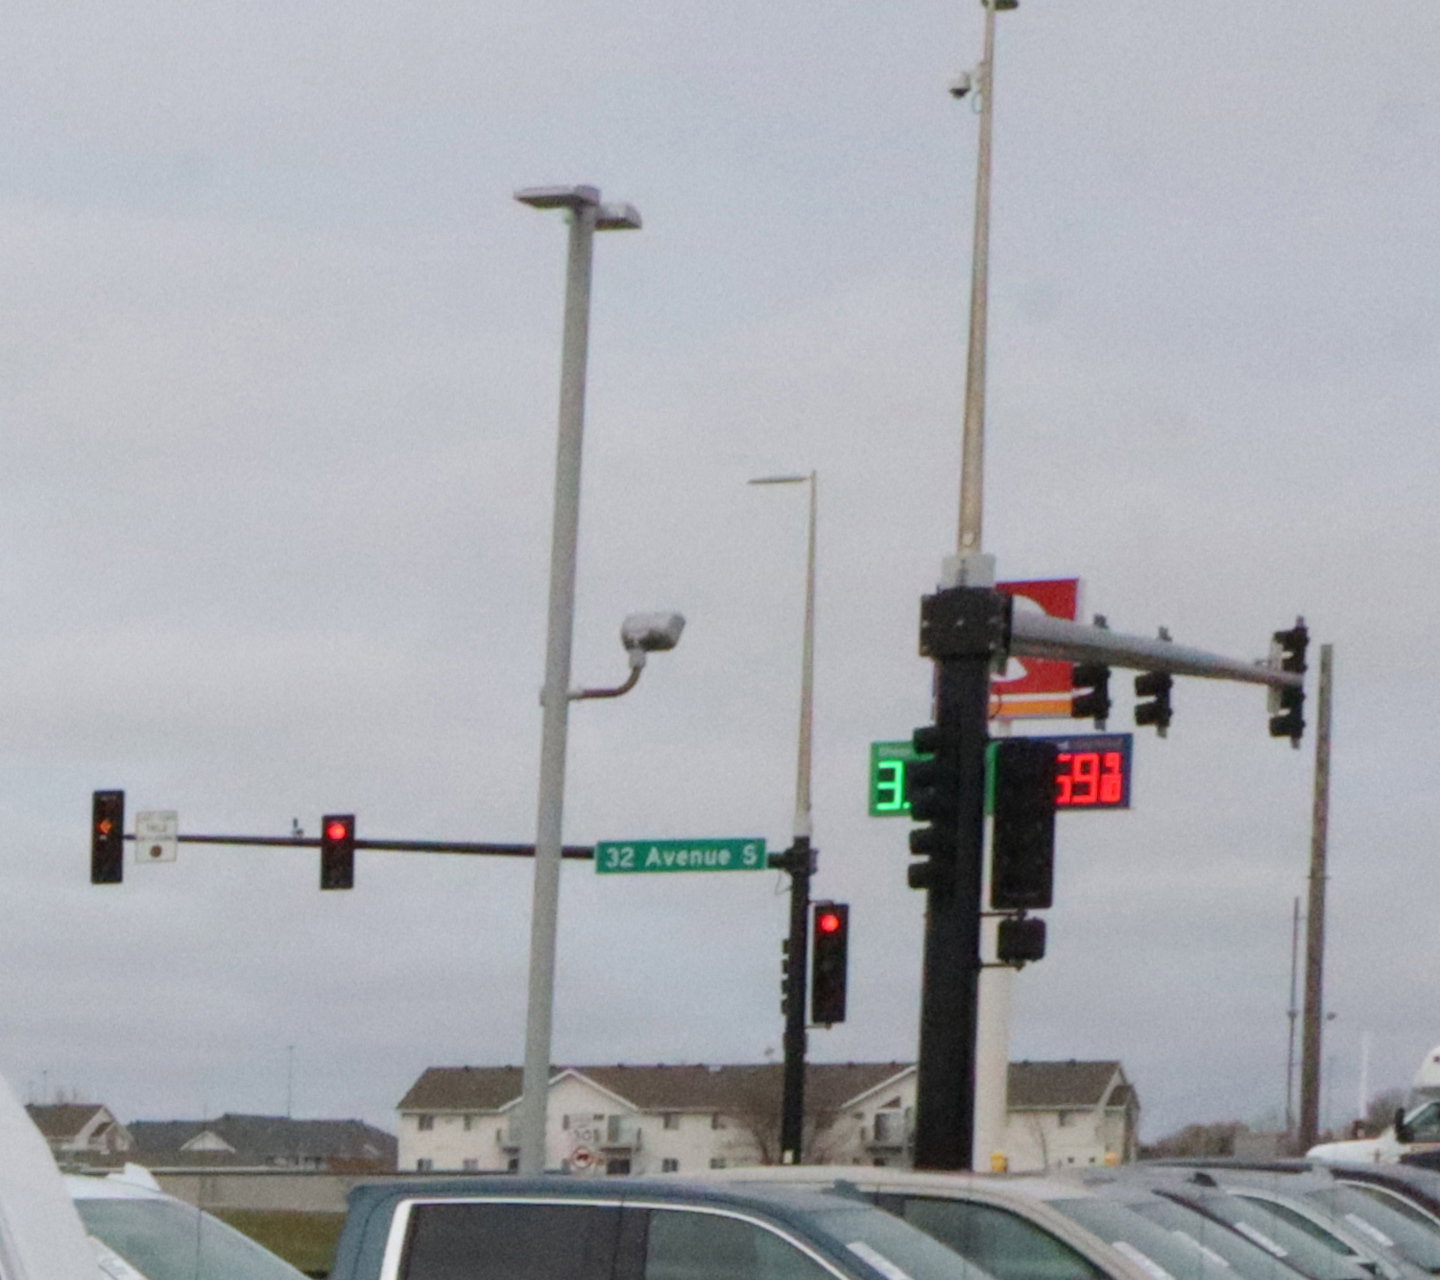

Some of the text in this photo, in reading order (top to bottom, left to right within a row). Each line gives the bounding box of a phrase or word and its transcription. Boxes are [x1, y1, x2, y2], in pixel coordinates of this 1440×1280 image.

[606, 844, 758, 868] 32 Avenue S
